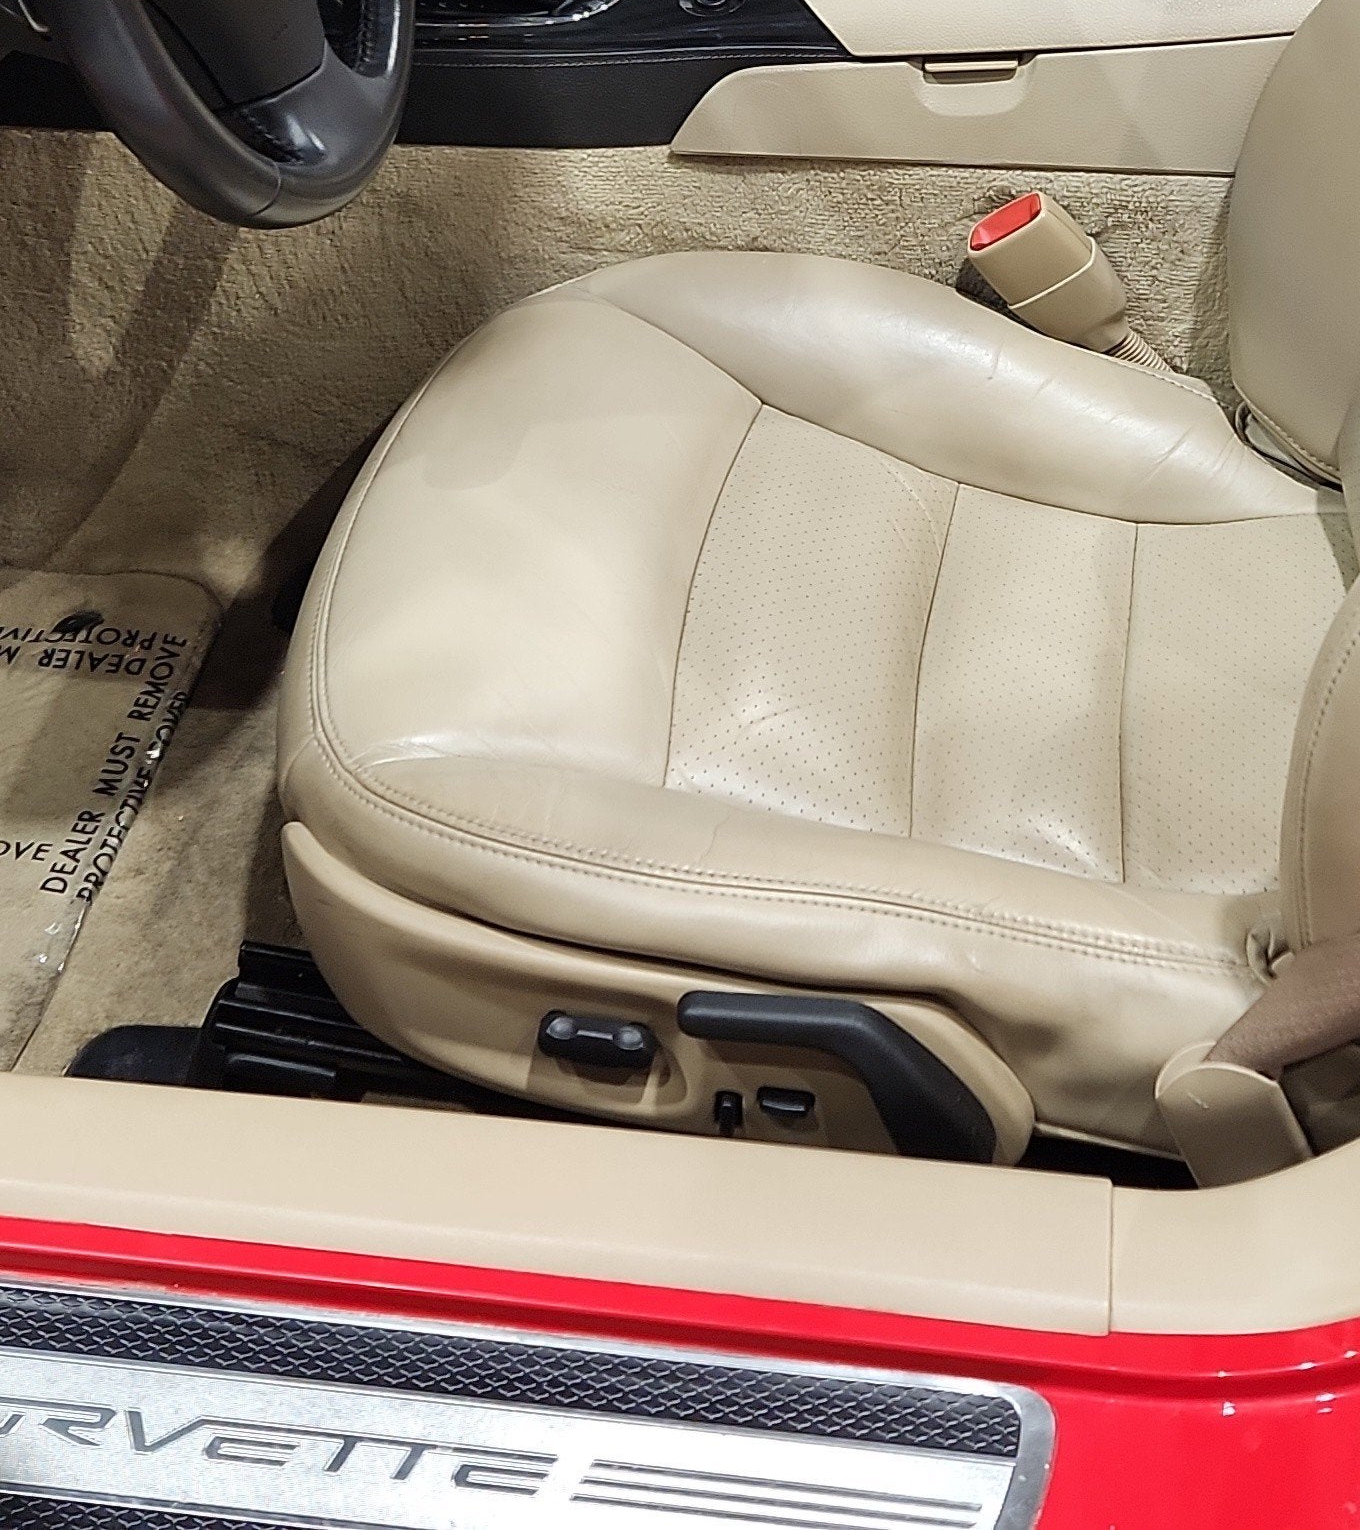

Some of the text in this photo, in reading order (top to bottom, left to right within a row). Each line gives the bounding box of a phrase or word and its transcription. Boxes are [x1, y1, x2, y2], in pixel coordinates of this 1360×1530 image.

[39, 648, 147, 676] DEALER
[40, 633, 187, 895] DEALER MUST REMOVE
